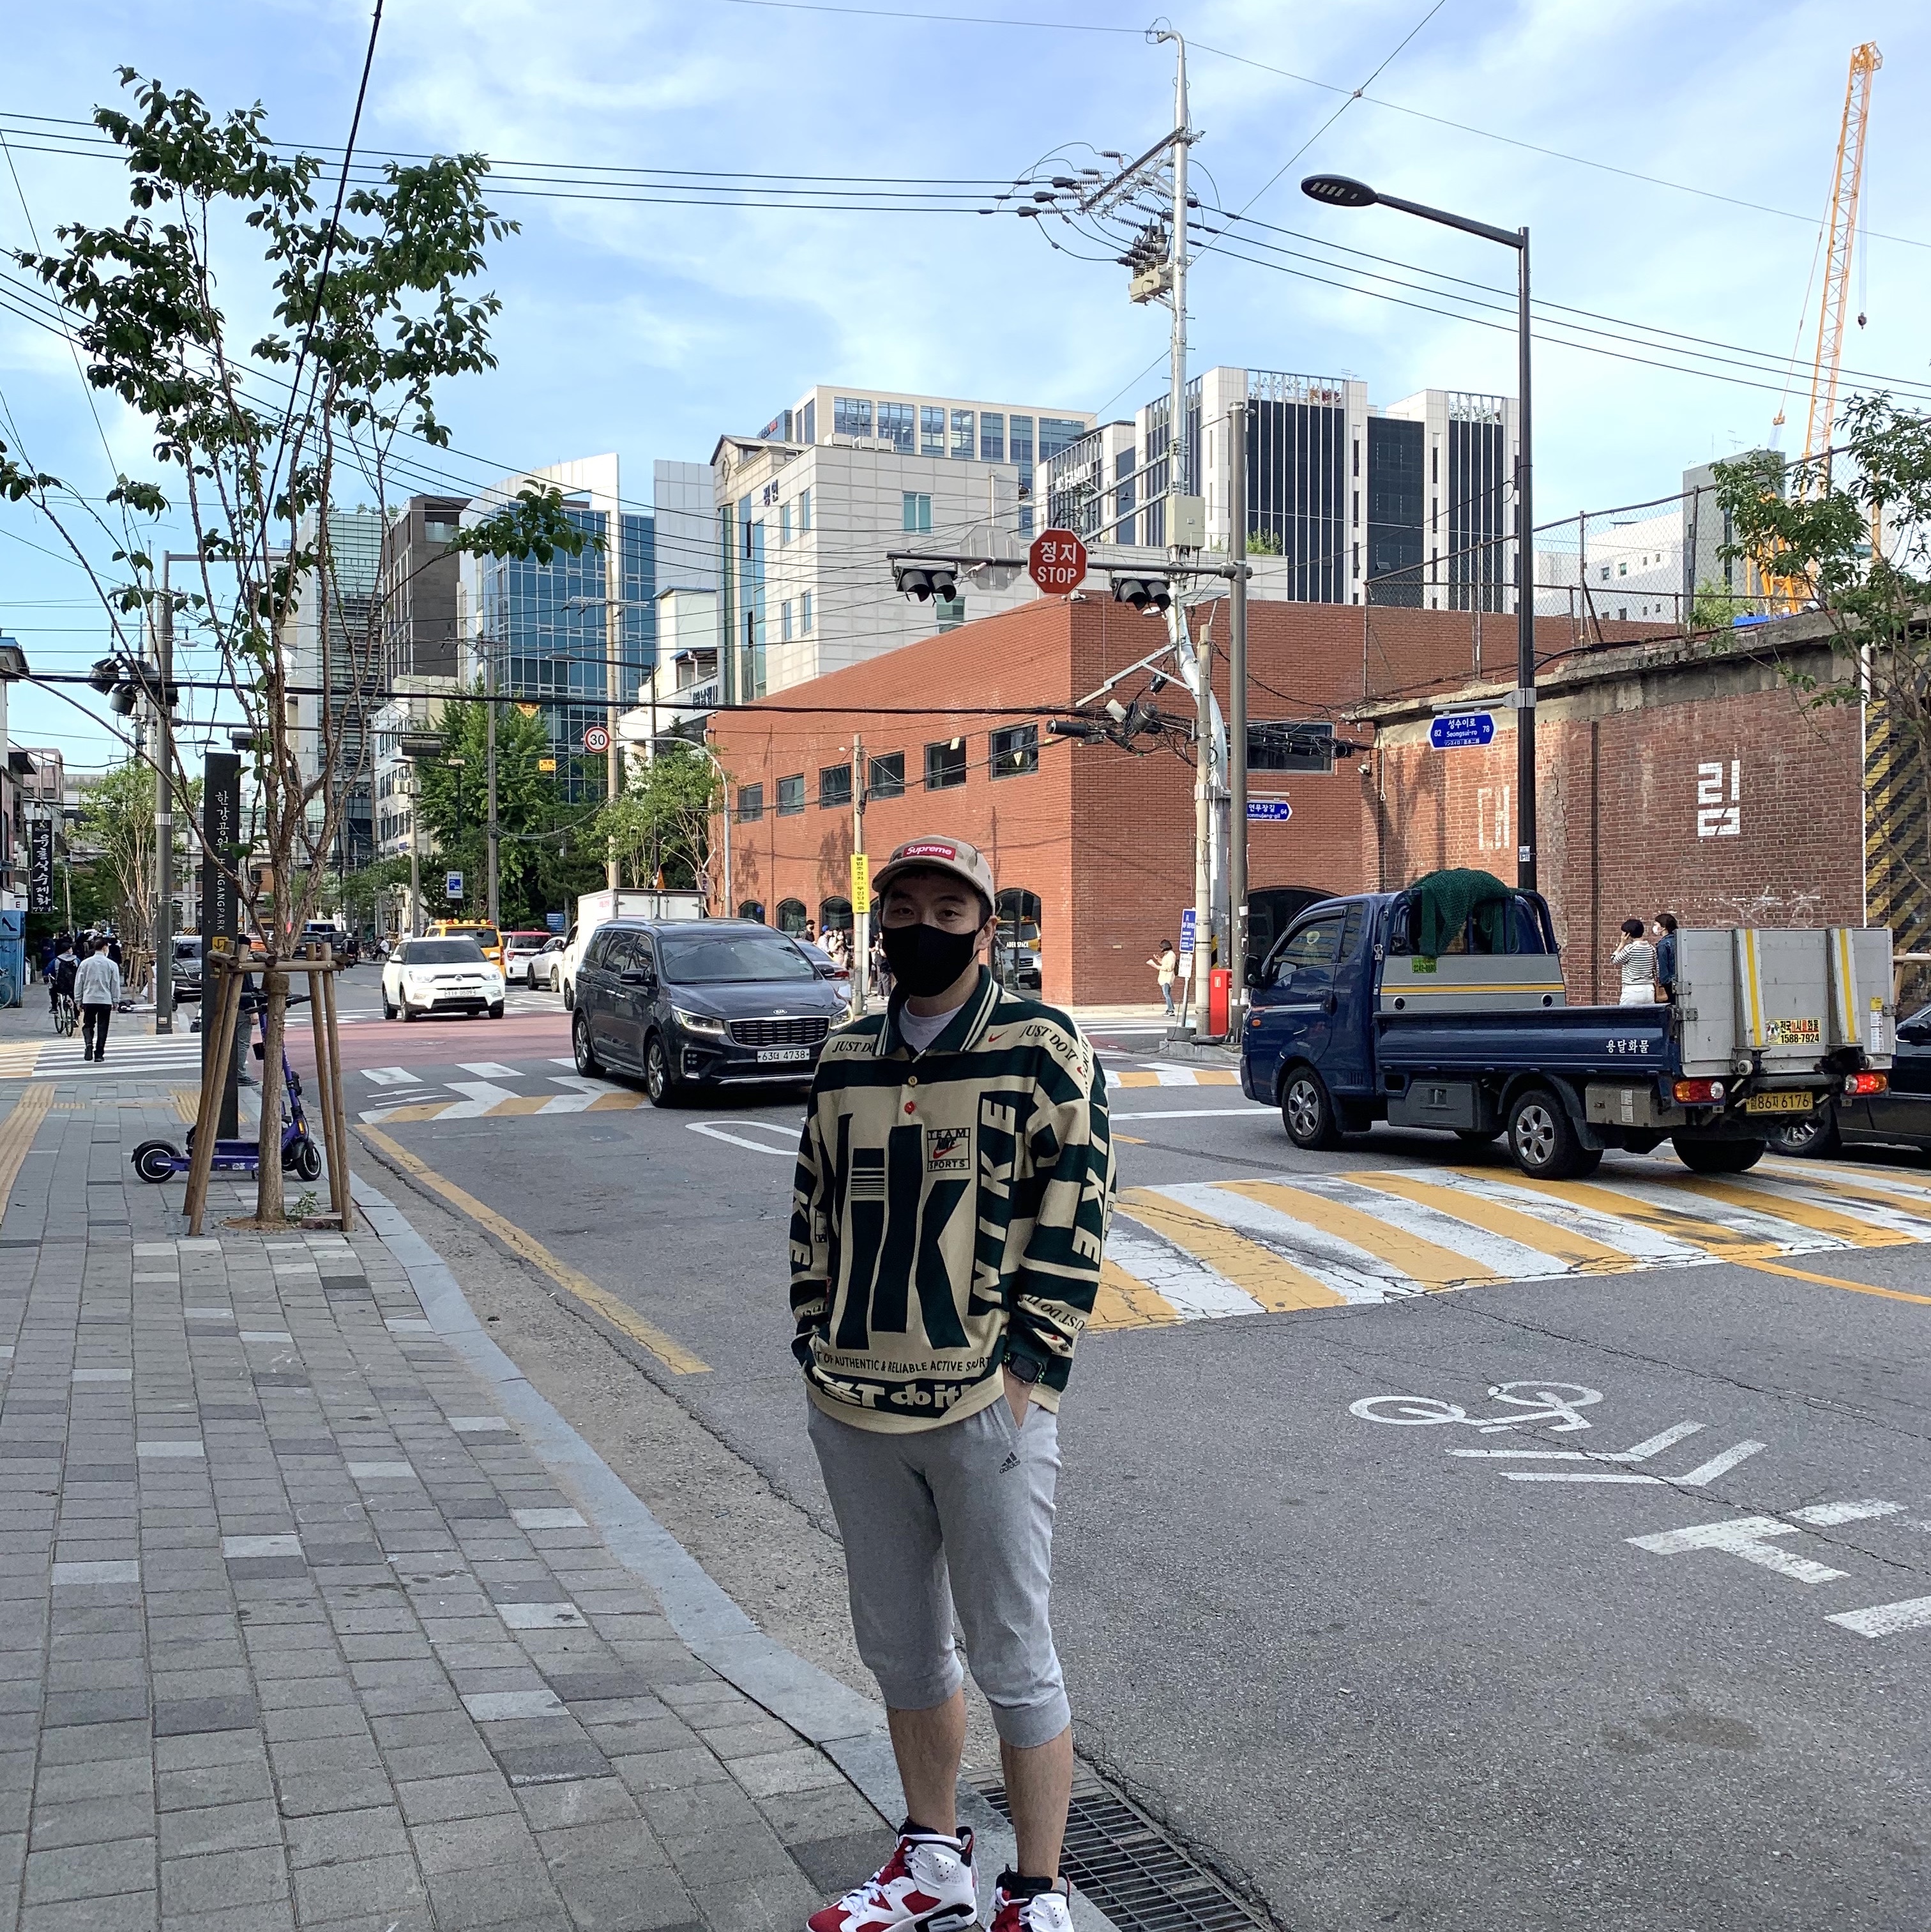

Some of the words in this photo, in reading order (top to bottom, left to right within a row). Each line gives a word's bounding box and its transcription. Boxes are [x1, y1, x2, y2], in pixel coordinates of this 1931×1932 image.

[1040, 541, 1077, 565] 정지
[1037, 566, 1077, 584] STOP
[1448, 718, 1476, 729] 성수이로
[590, 734, 605, 745] 30
[1446, 729, 1478, 738] Seongsui-ro
[1697, 759, 1741, 837] 림
[1248, 804, 1275, 812] 연무장길
[215, 790, 230, 851] 한강공원
[906, 846, 952, 855] Supreme
[216, 858, 225, 931] HNGANGPARK
[1019, 1025, 1052, 1038] JUST
[1049, 1034, 1068, 1052] DO
[1780, 1033, 1819, 1043] 1588-7924
[832, 1041, 861, 1053] JUST
[1605, 1039, 1649, 1054] 용달화물
[783, 1050, 805, 1060] 4738
[1781, 1094, 1809, 1108] 6176
[928, 1129, 966, 1139] TEAM
[936, 1137, 957, 1150] NIKE
[929, 1159, 965, 1169] SPORTS
[973, 1098, 1016, 1304] NIKE
[1040, 1304, 1063, 1319] DO
[835, 1355, 880, 1371] AUTHENTIC
[881, 1360, 886, 1371] &
[888, 1361, 928, 1374] RELIABLE
[930, 1360, 963, 1371] ACTIVE
[890, 1383, 932, 1406] do
[999, 1459, 1021, 1474] adidas
